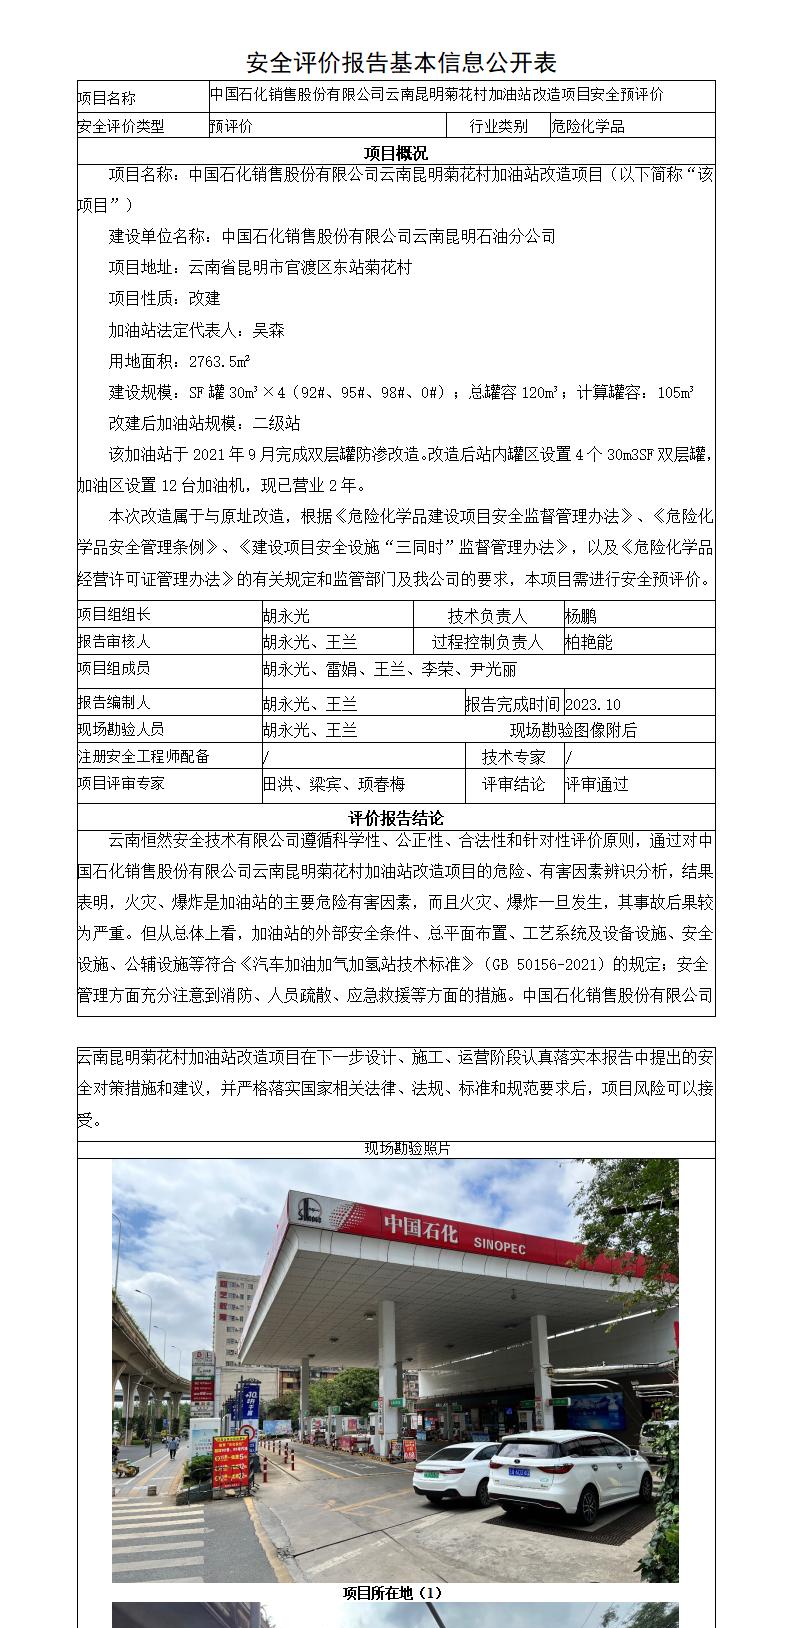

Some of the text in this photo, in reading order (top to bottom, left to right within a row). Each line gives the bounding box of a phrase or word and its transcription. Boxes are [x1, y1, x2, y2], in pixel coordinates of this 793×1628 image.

[247, 51, 556, 74] 安全评价报告基本信息公开表
[77, 91, 135, 105] 项目名称
[211, 87, 663, 101] 中国石化销售股份有限公司云南昆明菊花村加油站改造项目安全预评价
[77, 119, 164, 133] 安全评价类型
[210, 119, 252, 133] 预评价
[470, 119, 527, 133] 行业类别
[551, 119, 624, 133] 危险化学品
[364, 145, 428, 161] 项目概况
[77, 198, 131, 213] 项目”）
[109, 228, 554, 244] 建设单位名称：中国石化销售股份有限公司云南昆明石油分公司
[109, 259, 412, 275] 项目地址：云南省昆明市官渡区东站菊花村
[109, 290, 220, 306] 项目性质：改建
[109, 322, 284, 338] 加油站法定代表人：吴森
[109, 415, 300, 431] 改建后加油站规模：二级站
[109, 508, 713, 524] 本次改造属于与原址改造，根据《危险化学品建设项目安全监督管理办法》、《危险化
[77, 571, 708, 587] 经营许可证管理办法》的有关规定和监管部门及我公司的要求，本项目需进行安全预评价。
[77, 607, 150, 621] 项目组组长
[262, 608, 309, 624] 胡永光
[448, 608, 527, 624] 技术负责人
[564, 608, 596, 624] 杨鹏
[77, 634, 150, 648] 报告审核人
[262, 634, 357, 650] 胡永光、王兰
[432, 634, 543, 650] 过程控制负责人
[564, 634, 612, 650] 柏艳能
[77, 661, 149, 675] 项目组成员
[262, 661, 517, 677] 胡永光、雷娟、王兰、李荣、尹光丽
[77, 695, 150, 709] 报告编制人
[262, 696, 357, 712] 胡永光、王兰
[465, 696, 559, 712] 报告完成时间
[566, 699, 620, 710] 2023.10
[77, 722, 163, 736] 现场勘验人员
[262, 722, 357, 738] 胡永光、王兰
[510, 722, 637, 738] 现场勘验图像附后
[77, 749, 209, 763] 注册安全工程师配备
[482, 749, 545, 765] 技术专家
[77, 776, 164, 790] 项目评审专家
[482, 776, 545, 792] 评审结论
[564, 776, 628, 792] 评审通过
[348, 810, 444, 826] 评价报告结论
[109, 832, 712, 848] 云南恒然安全技术有限公司遵循科学性、公正性、合法性和针对性评价原则，通过对中
[77, 863, 713, 879] 国石化销售股份有限公司云南昆明菊花村加油站改造项目的危险、有害因素辨识分析，结果
[77, 894, 713, 910] 表明，火灾、爆炸是加油站的主要危险有害因素，而且火灾、爆炸一旦发生，其事故后果较
[77, 925, 713, 941] 为严重。但从总体上看，加油站的外部安全条件、总平面布置、工艺系统及设备设施、安全
[77, 987, 712, 1003] 管理方面充分注意到消防、人员疏散、应急救援等方面的措施。中国石化销售股份有限公司
[77, 1049, 713, 1065] 云南昆明菊花村加油站改造项目在下一步设计、施工、运营阶段认真落实本报告中提出的安
[77, 1080, 713, 1096] 全对策措施和建议，并严格落实国家相关法律、法规、标准和规范要求后，项目风险可以接
[77, 1112, 99, 1128] 受。
[365, 1142, 451, 1156] 现场勘验照片
[384, 1213, 459, 1244] 中国石化
[474, 1237, 527, 1255] SINOPEC
[343, 1586, 441, 1602] 项目所在地（1）
